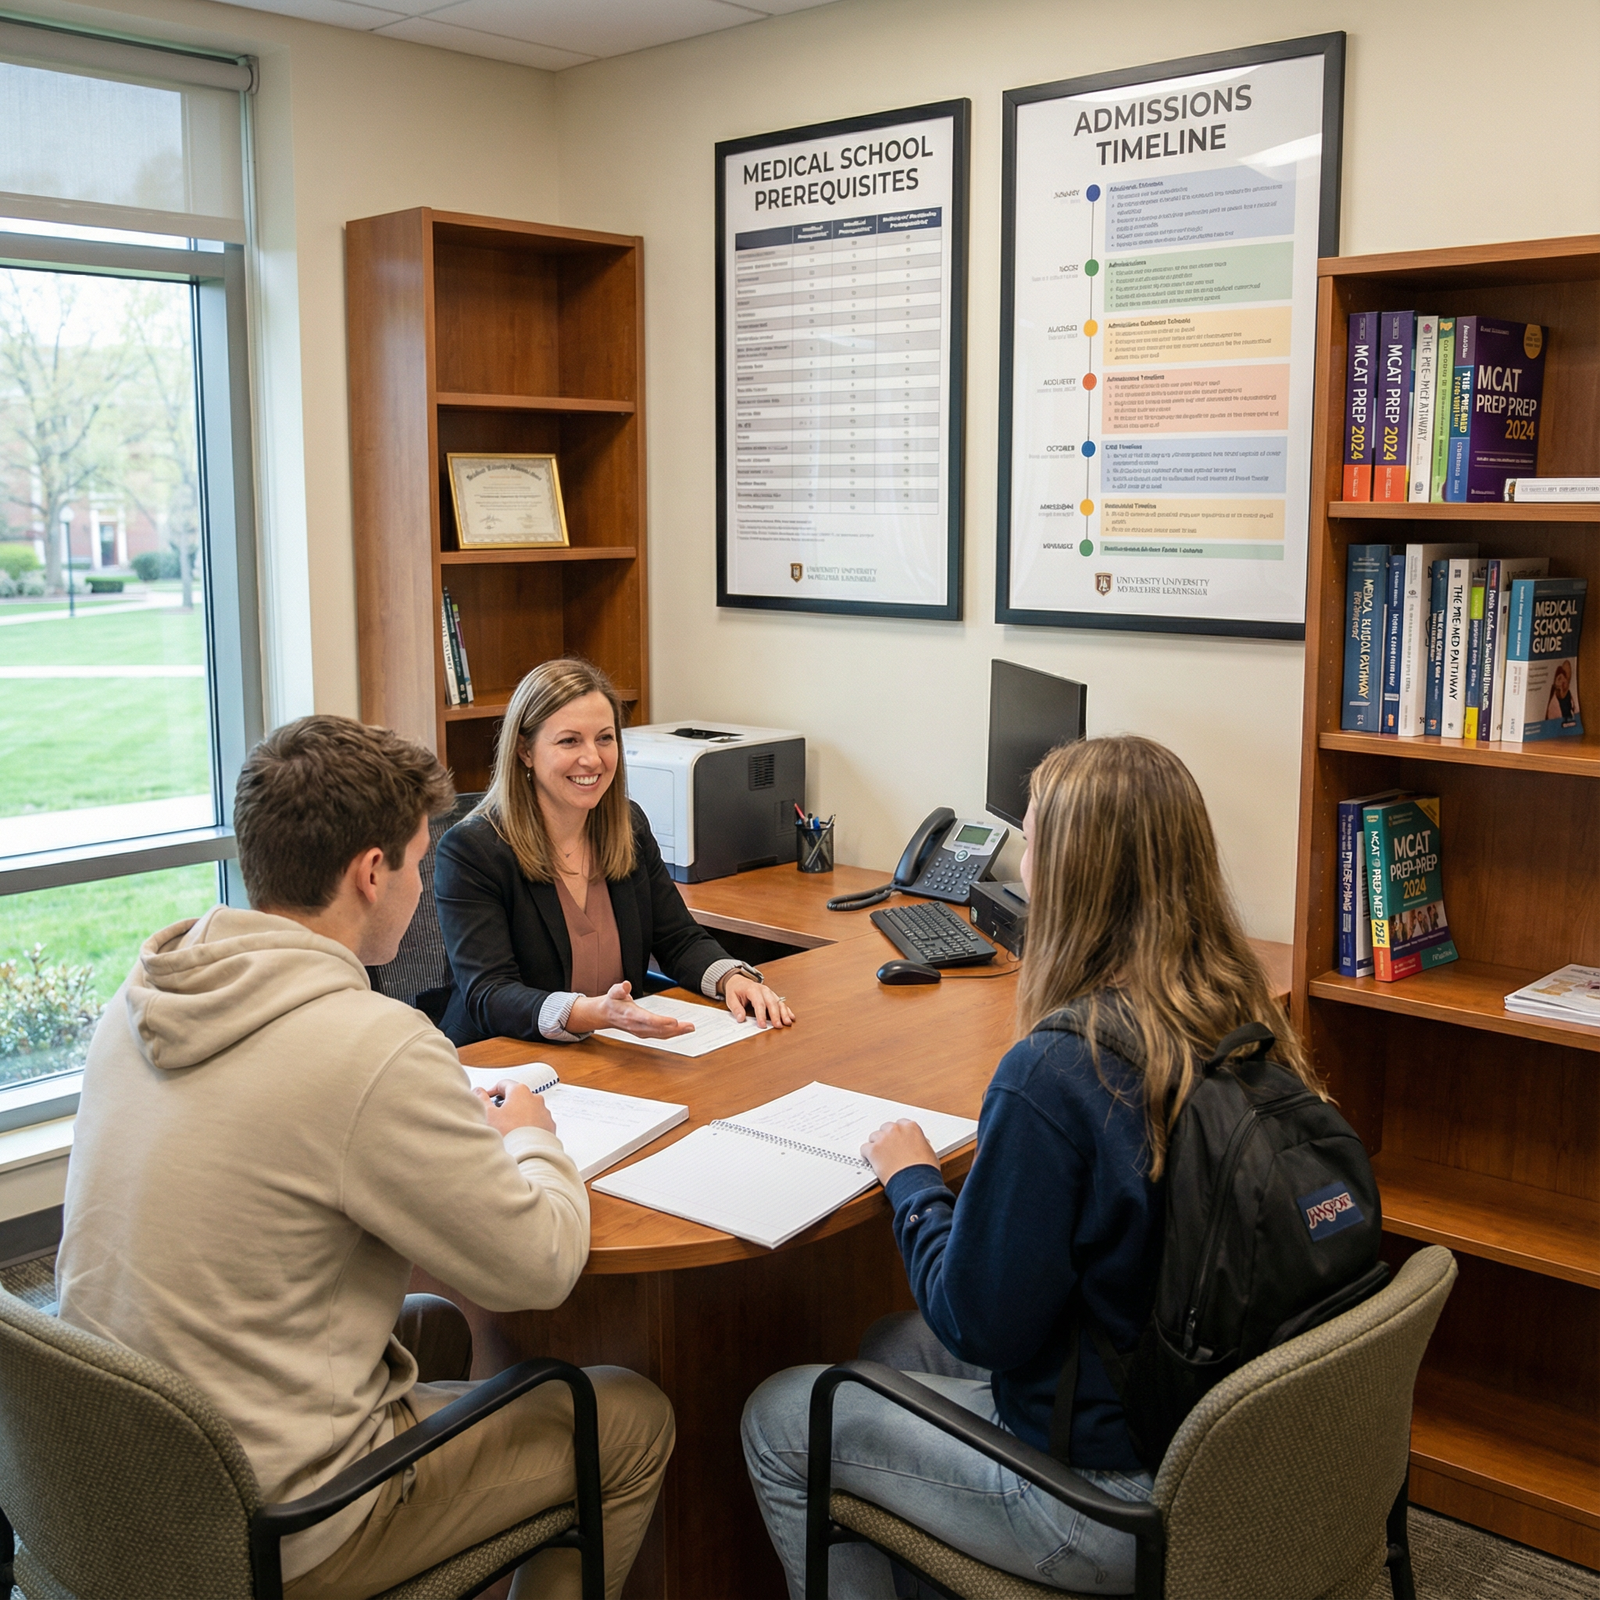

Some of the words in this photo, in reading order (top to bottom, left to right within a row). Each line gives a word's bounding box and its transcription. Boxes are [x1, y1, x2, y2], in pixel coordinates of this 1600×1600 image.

[1073, 84, 1252, 136] ADMISSIONS
[743, 151, 834, 185] MEDICAL
[840, 135, 933, 170] SCHOOL
[1096, 124, 1226, 166] TIMELINE
[754, 168, 919, 211] PREREQUISITES
[1353, 345, 1369, 384] MCAT
[1387, 344, 1403, 384] MCAT
[1477, 365, 1522, 393] MCAT
[1352, 389, 1367, 423] PREP
[1385, 389, 1400, 423] PREP
[1476, 394, 1506, 414] PREP
[1507, 397, 1537, 417] PREP
[1351, 426, 1365, 460] 2024
[1383, 426, 1398, 461] 2024
[1505, 420, 1535, 440] 2024
[1535, 600, 1577, 617] MEDICAL
[1533, 617, 1573, 636] SCHOOL
[1532, 636, 1563, 653] GUIDE
[1394, 830, 1431, 861] MCAT
[1403, 876, 1427, 899] 2024
